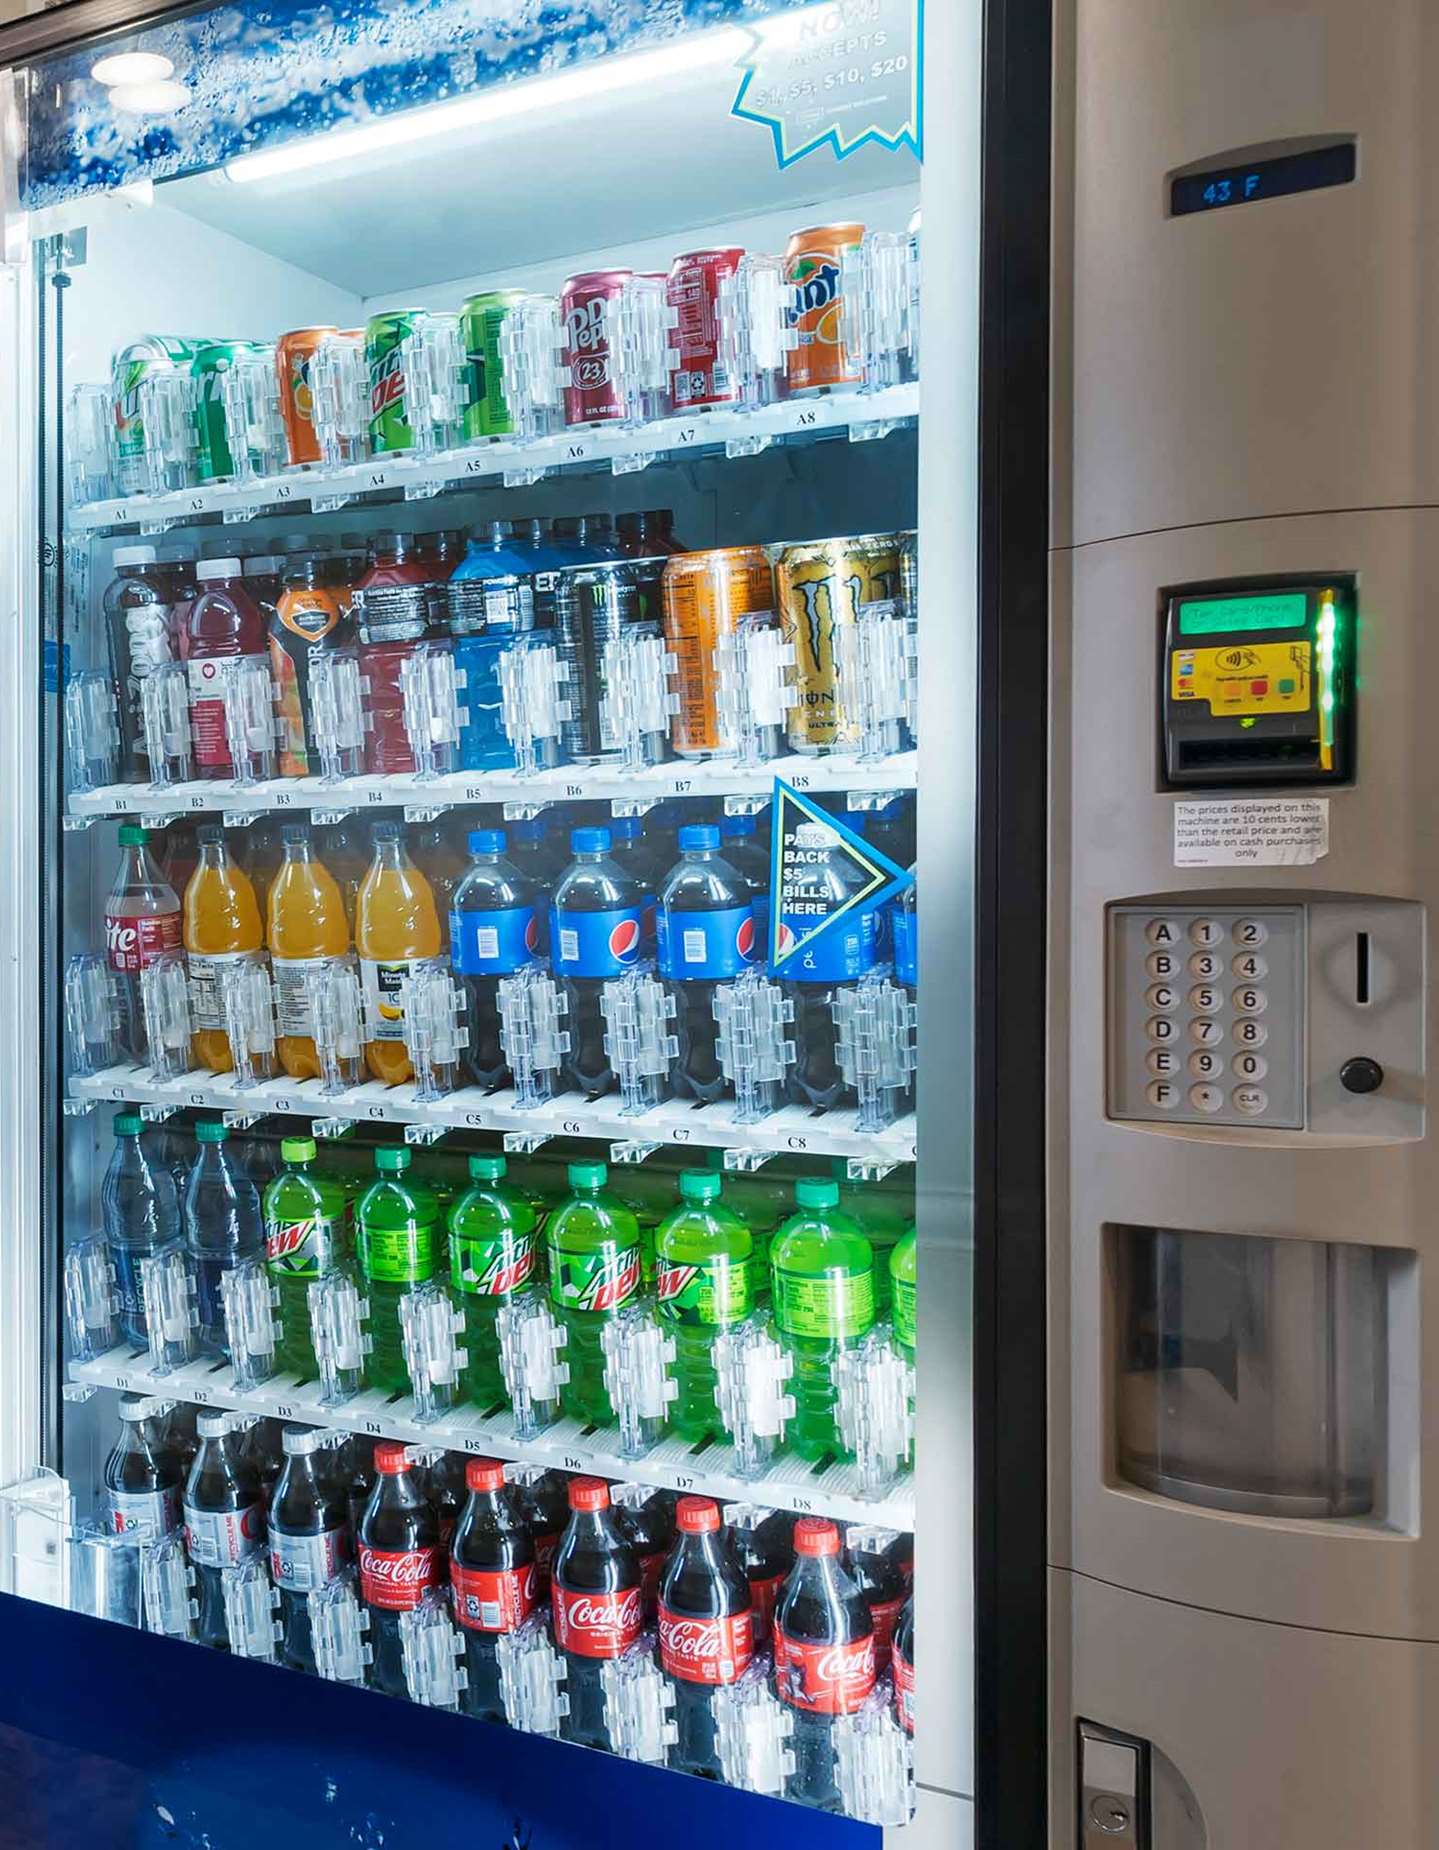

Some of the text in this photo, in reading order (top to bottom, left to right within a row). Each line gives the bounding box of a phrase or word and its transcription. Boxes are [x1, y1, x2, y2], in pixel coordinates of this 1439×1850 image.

[871, 56, 908, 77] $20
[1203, 175, 1259, 203] 43 F
[581, 362, 601, 380] 23
[796, 412, 816, 425] A8
[678, 429, 695, 442] A7
[567, 445, 584, 457] A6
[465, 460, 480, 473] A5
[369, 474, 385, 486] A4
[276, 486, 290, 498] A3
[190, 499, 204, 511] A2
[114, 510, 128, 521] A1
[675, 780, 691, 793] B7
[791, 776, 810, 788] B8
[466, 788, 480, 800] B5
[566, 784, 583, 796] B6
[191, 797, 204, 808] B2
[276, 794, 290, 806] B3
[368, 791, 383, 803] B4
[115, 799, 128, 810] B1
[1177, 807, 1195, 815] The
[1198, 806, 1228, 815] prices
[1231, 804, 1281, 814] displayed
[1301, 803, 1321, 812] this
[1177, 814, 1320, 826] machine are 10 cents lower
[1177, 828, 1198, 836] than
[1201, 827, 1219, 835] the
[1221, 826, 1248, 835] retail
[1251, 825, 1277, 835] price
[1281, 824, 1301, 834] and
[784, 834, 825, 847] PAYS
[1177, 837, 1321, 848] available on cash purchases
[784, 851, 830, 864] BACK
[1235, 850, 1258, 858] only
[783, 868, 803, 881] $5
[782, 885, 829, 898] BILLS
[782, 903, 827, 915] HERE
[1156, 925, 1171, 941] A
[1202, 926, 1210, 941] 1
[1244, 926, 1257, 941] 2
[1157, 957, 1170, 973] B
[1200, 958, 1212, 974] 3
[1243, 959, 1257, 974] 4
[1156, 989, 1171, 1005] C
[1200, 990, 1212, 1006] 5
[1243, 991, 1257, 1007] 6
[1157, 1022, 1171, 1037] D
[1200, 1023, 1212, 1039] 7
[1243, 1024, 1256, 1040] 8
[1157, 1054, 1170, 1070] E
[1200, 1056, 1212, 1072] 9
[1243, 1057, 1256, 1073] 0
[112, 1087, 126, 1098] C1
[1157, 1086, 1170, 1102] F
[190, 1094, 204, 1105] C2
[275, 1099, 290, 1111] C3
[369, 1107, 384, 1119] C4
[466, 1113, 481, 1125] C5
[563, 1121, 580, 1134] C6
[673, 1128, 690, 1142] C7
[788, 1135, 807, 1149] C8
[115, 1376, 129, 1388] D1
[194, 1391, 208, 1402] D2
[277, 1405, 292, 1417] D3
[366, 1421, 381, 1434] D4
[464, 1438, 480, 1450] D5
[564, 1456, 582, 1469] D6
[676, 1476, 694, 1489] D7
[793, 1497, 811, 1511] D8
[361, 1549, 431, 1583] Coca-Cola
